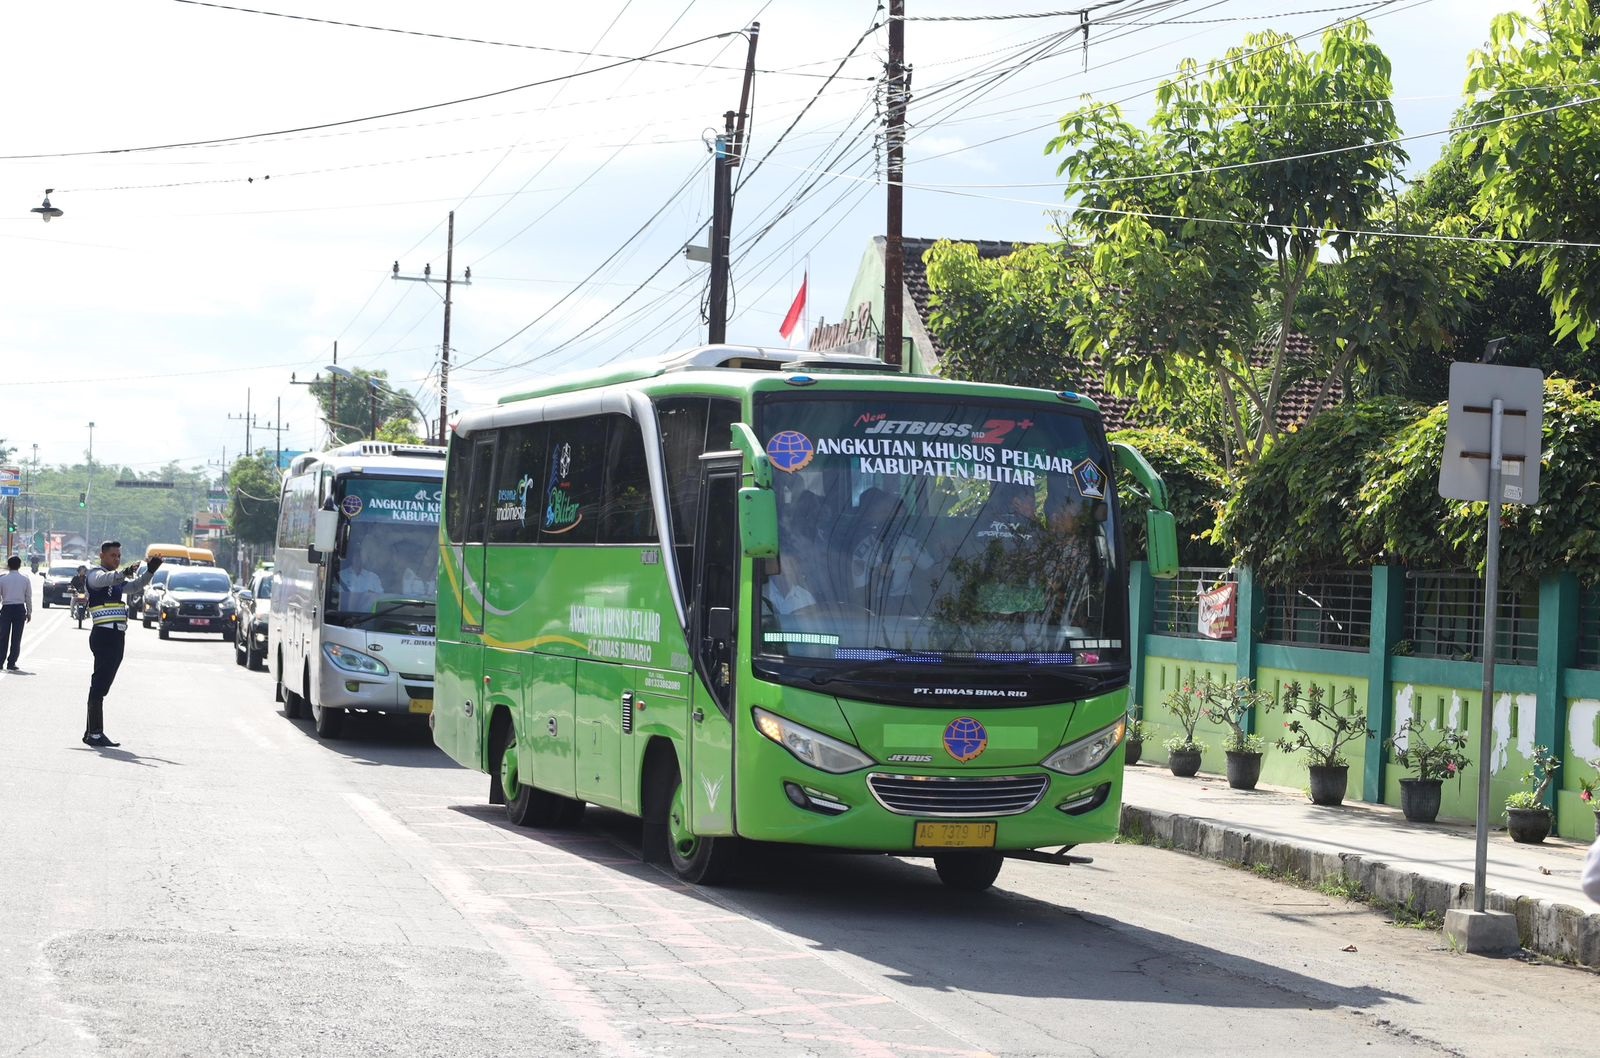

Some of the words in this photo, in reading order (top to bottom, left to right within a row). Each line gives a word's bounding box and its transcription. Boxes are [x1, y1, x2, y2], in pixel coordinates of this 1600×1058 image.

[854, 412, 887, 427] New
[865, 419, 973, 437] JETBUSS
[971, 431, 985, 439] MD
[815, 438, 916, 457] ANGKUTAN
[922, 441, 996, 463] KHUSUS
[1001, 448, 1074, 475] PELAJAR
[860, 457, 968, 480] KABUPATEN
[973, 463, 1036, 487] BLITAR
[368, 498, 424, 511] ANGKUTAN
[392, 510, 440, 523] KABUPAT
[569, 604, 602, 634] ANGKUTAN
[602, 607, 629, 639] KHUSUS
[630, 610, 661, 643] PELAJAR
[620, 642, 652, 663] BIMARIO
[913, 687, 933, 695] PT.
[934, 688, 974, 696] DIMAS
[975, 689, 1006, 697] BIMA
[887, 754, 933, 762] JETBUS
[920, 824, 935, 839] AG
[941, 824, 969, 839] 7379
[977, 824, 992, 840] UP
